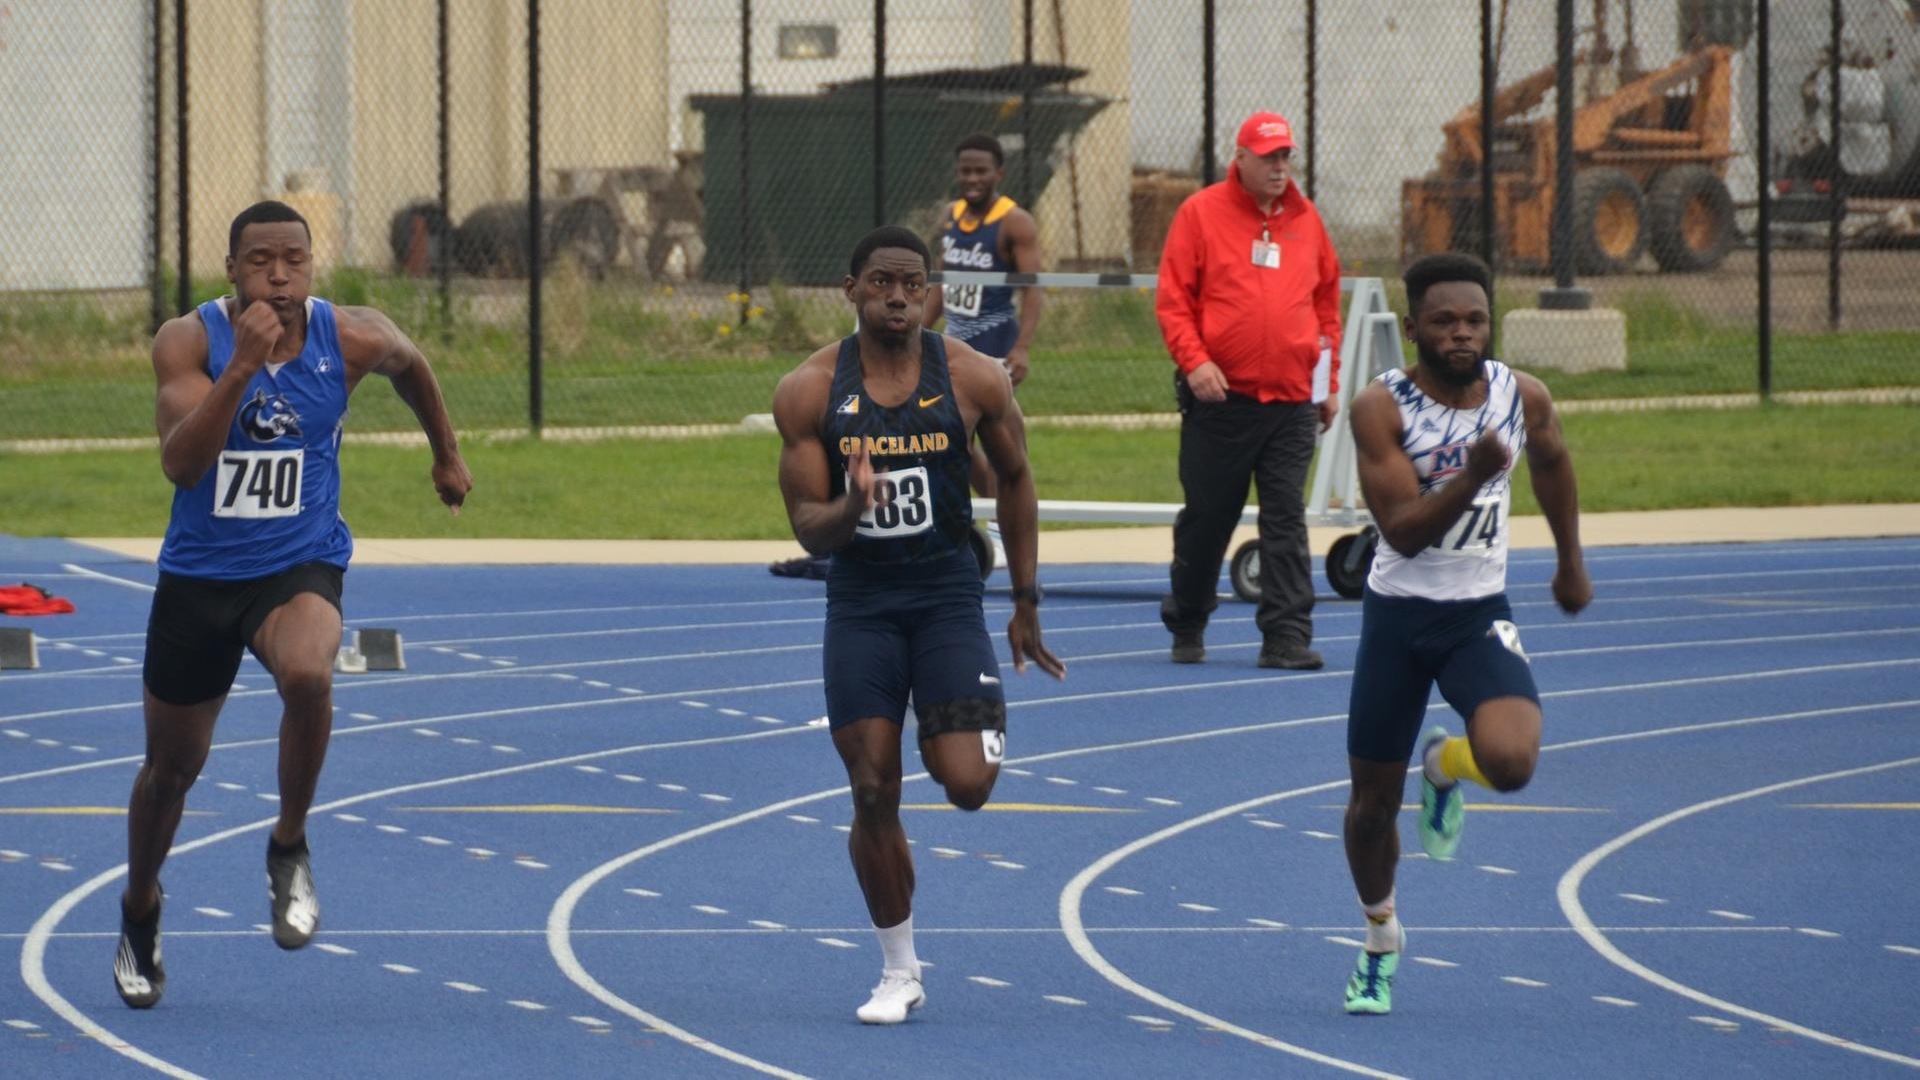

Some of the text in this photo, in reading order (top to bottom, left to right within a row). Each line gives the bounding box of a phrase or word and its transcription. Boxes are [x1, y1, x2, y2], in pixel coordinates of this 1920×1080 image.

[838, 431, 949, 456] GRACELAND
[221, 456, 299, 509] 740
[858, 474, 927, 530] 83
[1431, 502, 1500, 549] 74
